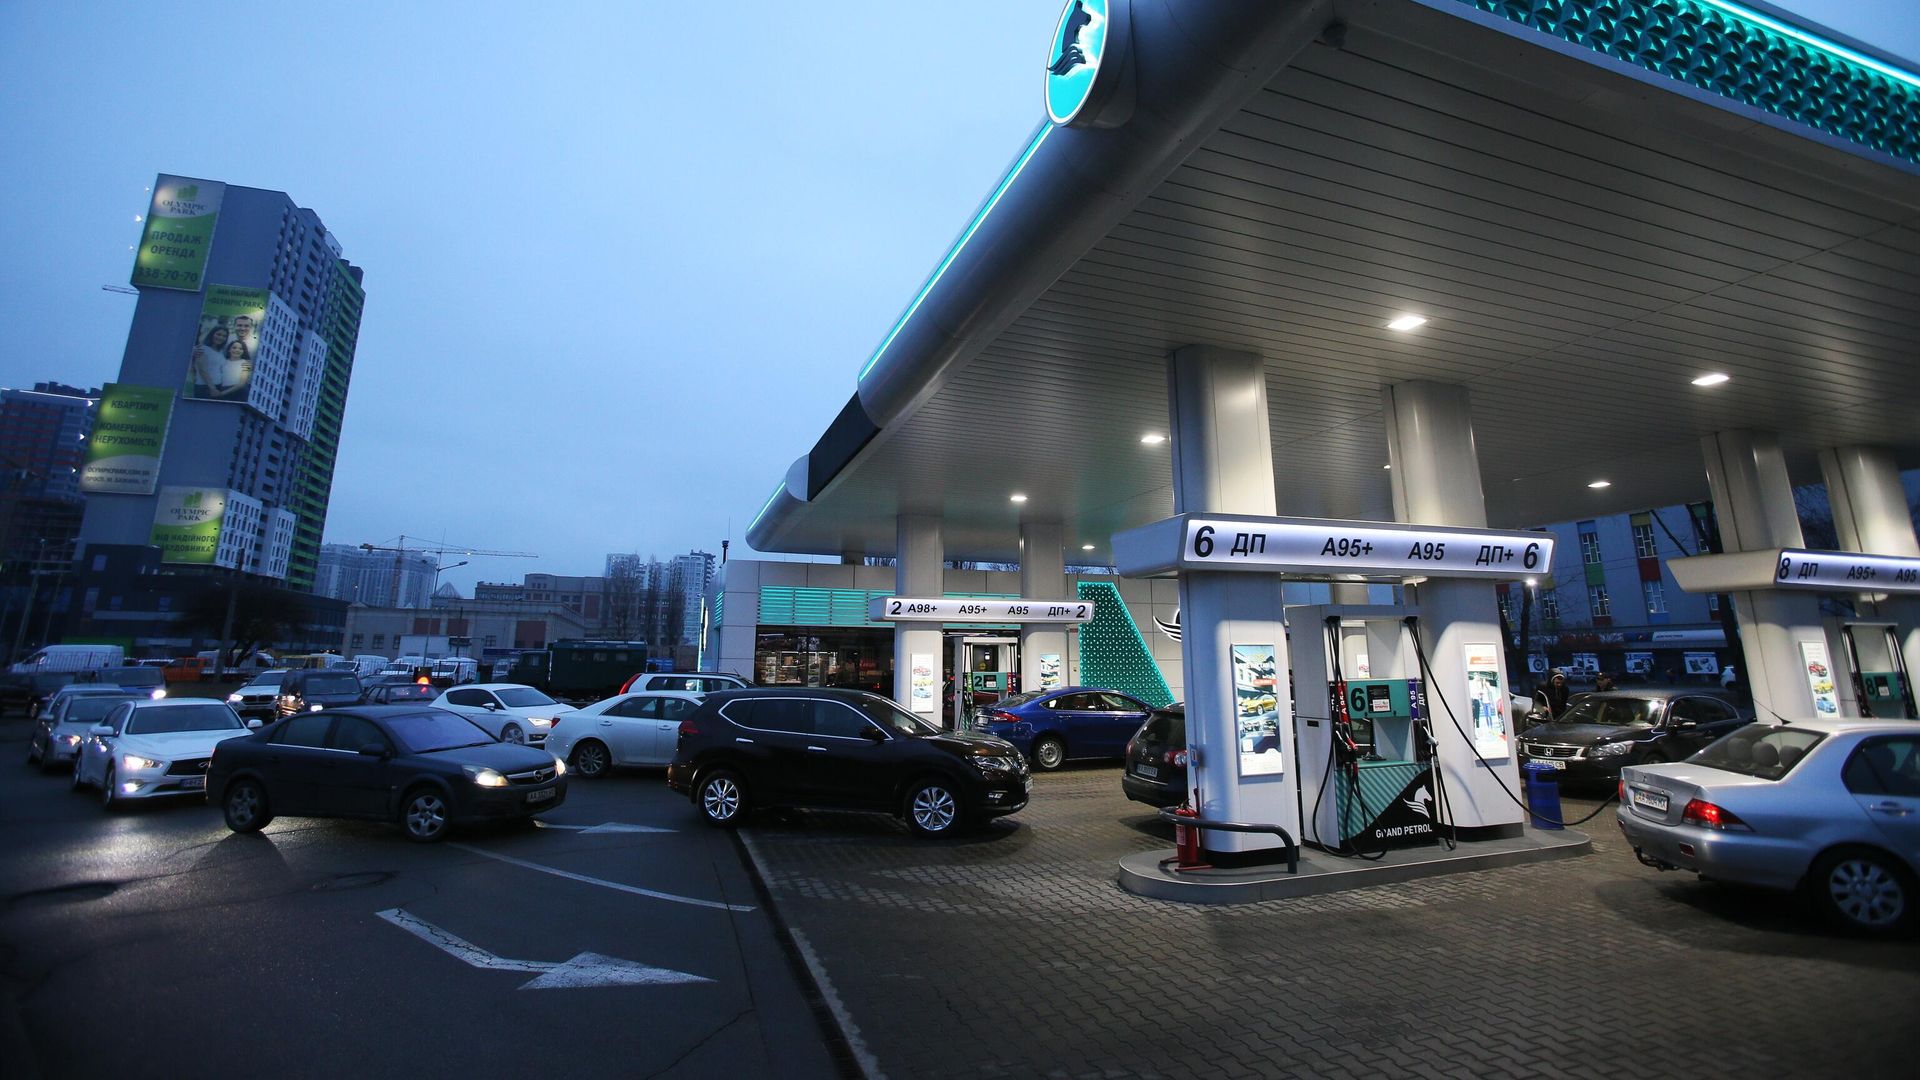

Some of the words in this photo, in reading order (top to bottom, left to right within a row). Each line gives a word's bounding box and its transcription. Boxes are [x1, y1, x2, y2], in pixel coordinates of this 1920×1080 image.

[162, 200, 207, 211] OLYMPIC
[170, 207, 196, 216] PARK
[152, 231, 203, 244] ПРОДАЖ
[151, 245, 196, 258] ОРЕНДА
[95, 435, 158, 447] НЕРУХОМІСТЬ
[1194, 525, 1215, 557] 6
[1230, 533, 1266, 557] ДП
[1321, 537, 1373, 557] А95+
[1408, 541, 1445, 560] А95
[1476, 545, 1514, 566] ДП+
[1523, 542, 1539, 569] 6
[1779, 557, 1791, 580] 8
[1798, 562, 1818, 579] ДП
[1847, 565, 1877, 580] А95+
[1895, 567, 1918, 583] А95
[891, 600, 902, 615] 2
[908, 603, 938, 613] А98+
[958, 605, 988, 614] А95+
[1007, 605, 1029, 615] А95
[1047, 606, 1071, 617] ДП+
[1075, 605, 1086, 618] 2
[974, 675, 983, 687] 2
[1865, 678, 1875, 696] 8
[1350, 687, 1366, 712] 6
[1404, 823, 1433, 835] PETROL
